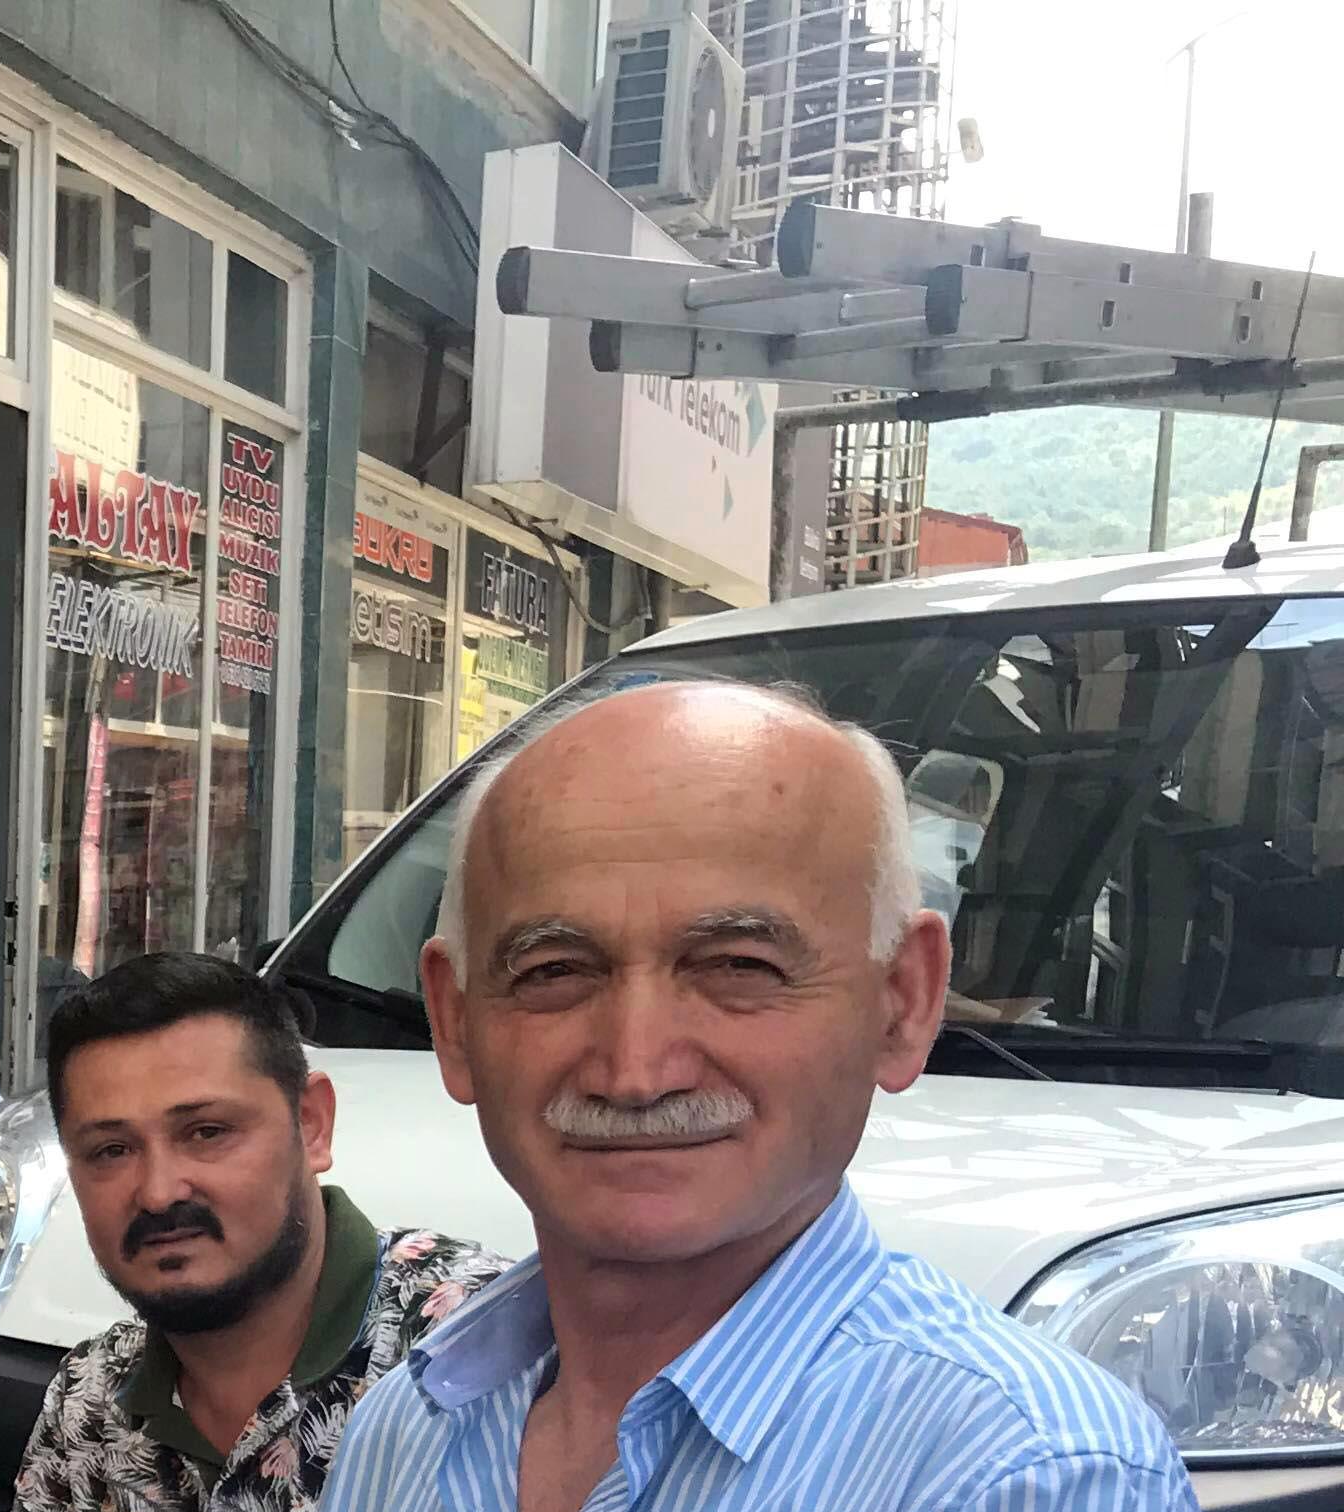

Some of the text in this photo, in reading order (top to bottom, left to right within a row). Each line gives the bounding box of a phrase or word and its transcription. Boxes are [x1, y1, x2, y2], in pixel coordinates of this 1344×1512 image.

[227, 432, 274, 474] TV
[222, 463, 281, 510] UYDU
[48, 447, 201, 578] ALTAY
[219, 494, 281, 540] ALICISI
[217, 529, 281, 577] MÜZİK
[215, 593, 280, 640] TELEFON
[480, 551, 550, 637] FATURA
